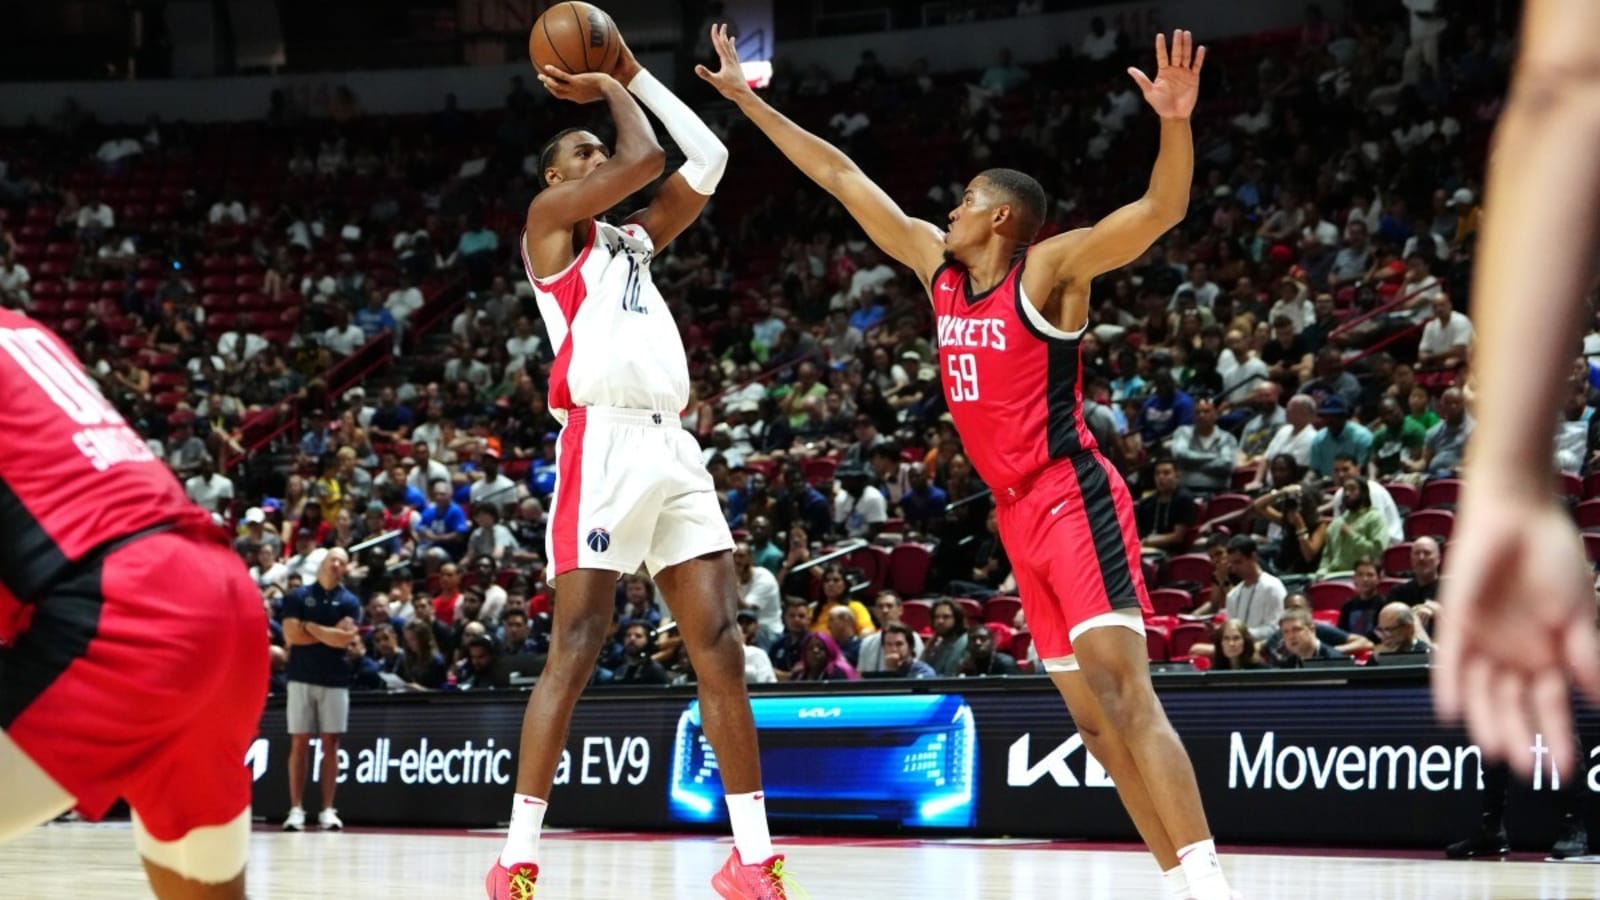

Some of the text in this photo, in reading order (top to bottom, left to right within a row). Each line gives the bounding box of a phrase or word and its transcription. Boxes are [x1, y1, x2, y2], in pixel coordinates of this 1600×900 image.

[948, 353, 979, 402] 59
[307, 738, 350, 784] Te
[355, 737, 512, 785] all-electric
[581, 736, 650, 786] EV9
[1006, 732, 1118, 788] KI
[1228, 731, 1486, 791] Movemen
